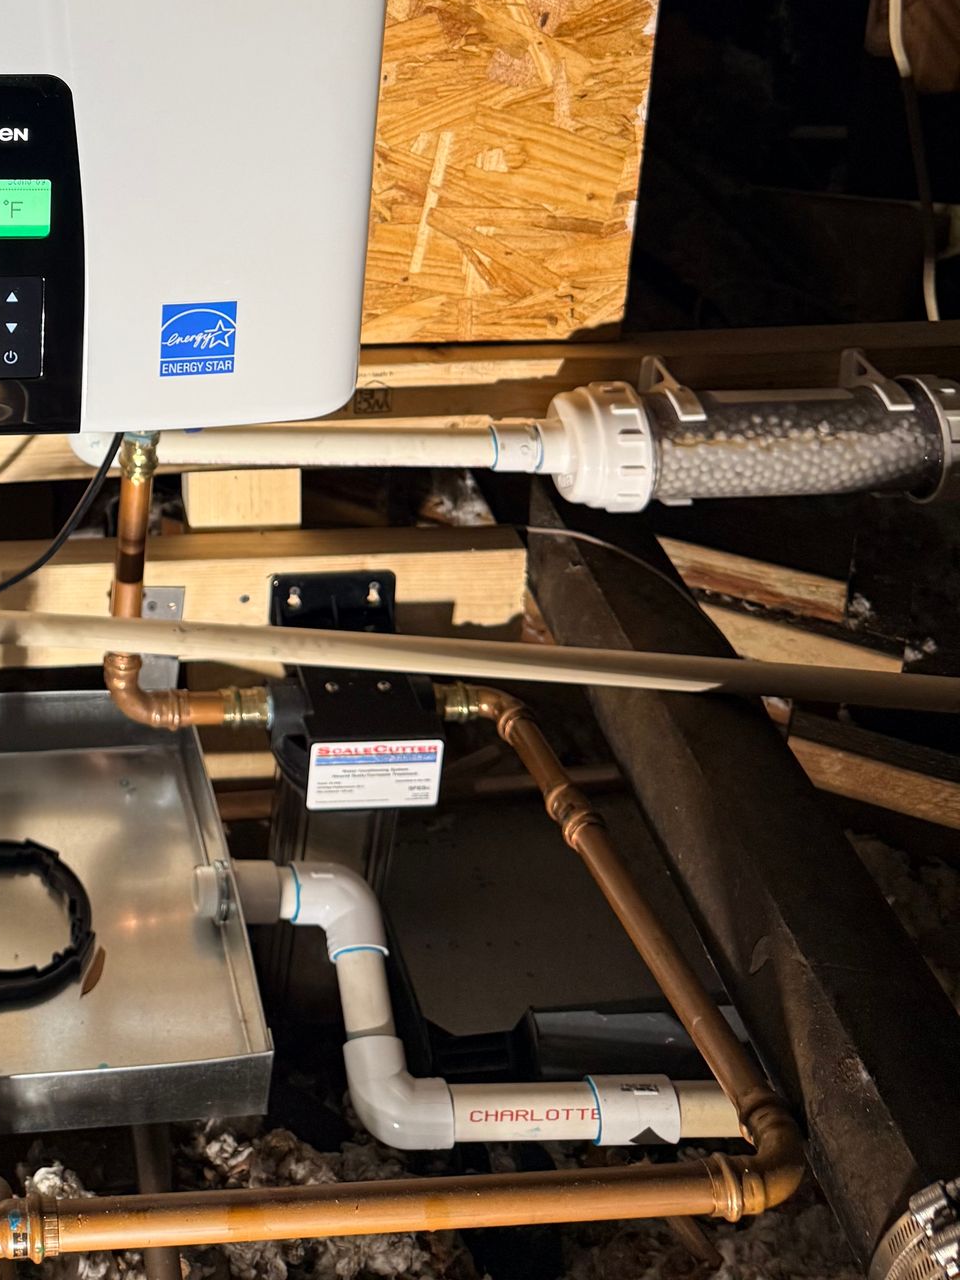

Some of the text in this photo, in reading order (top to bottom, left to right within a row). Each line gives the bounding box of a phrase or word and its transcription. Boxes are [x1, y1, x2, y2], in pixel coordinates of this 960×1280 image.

[162, 360, 232, 374] ENERGY STAR
[469, 1107, 601, 1123] CHARLOTTE
